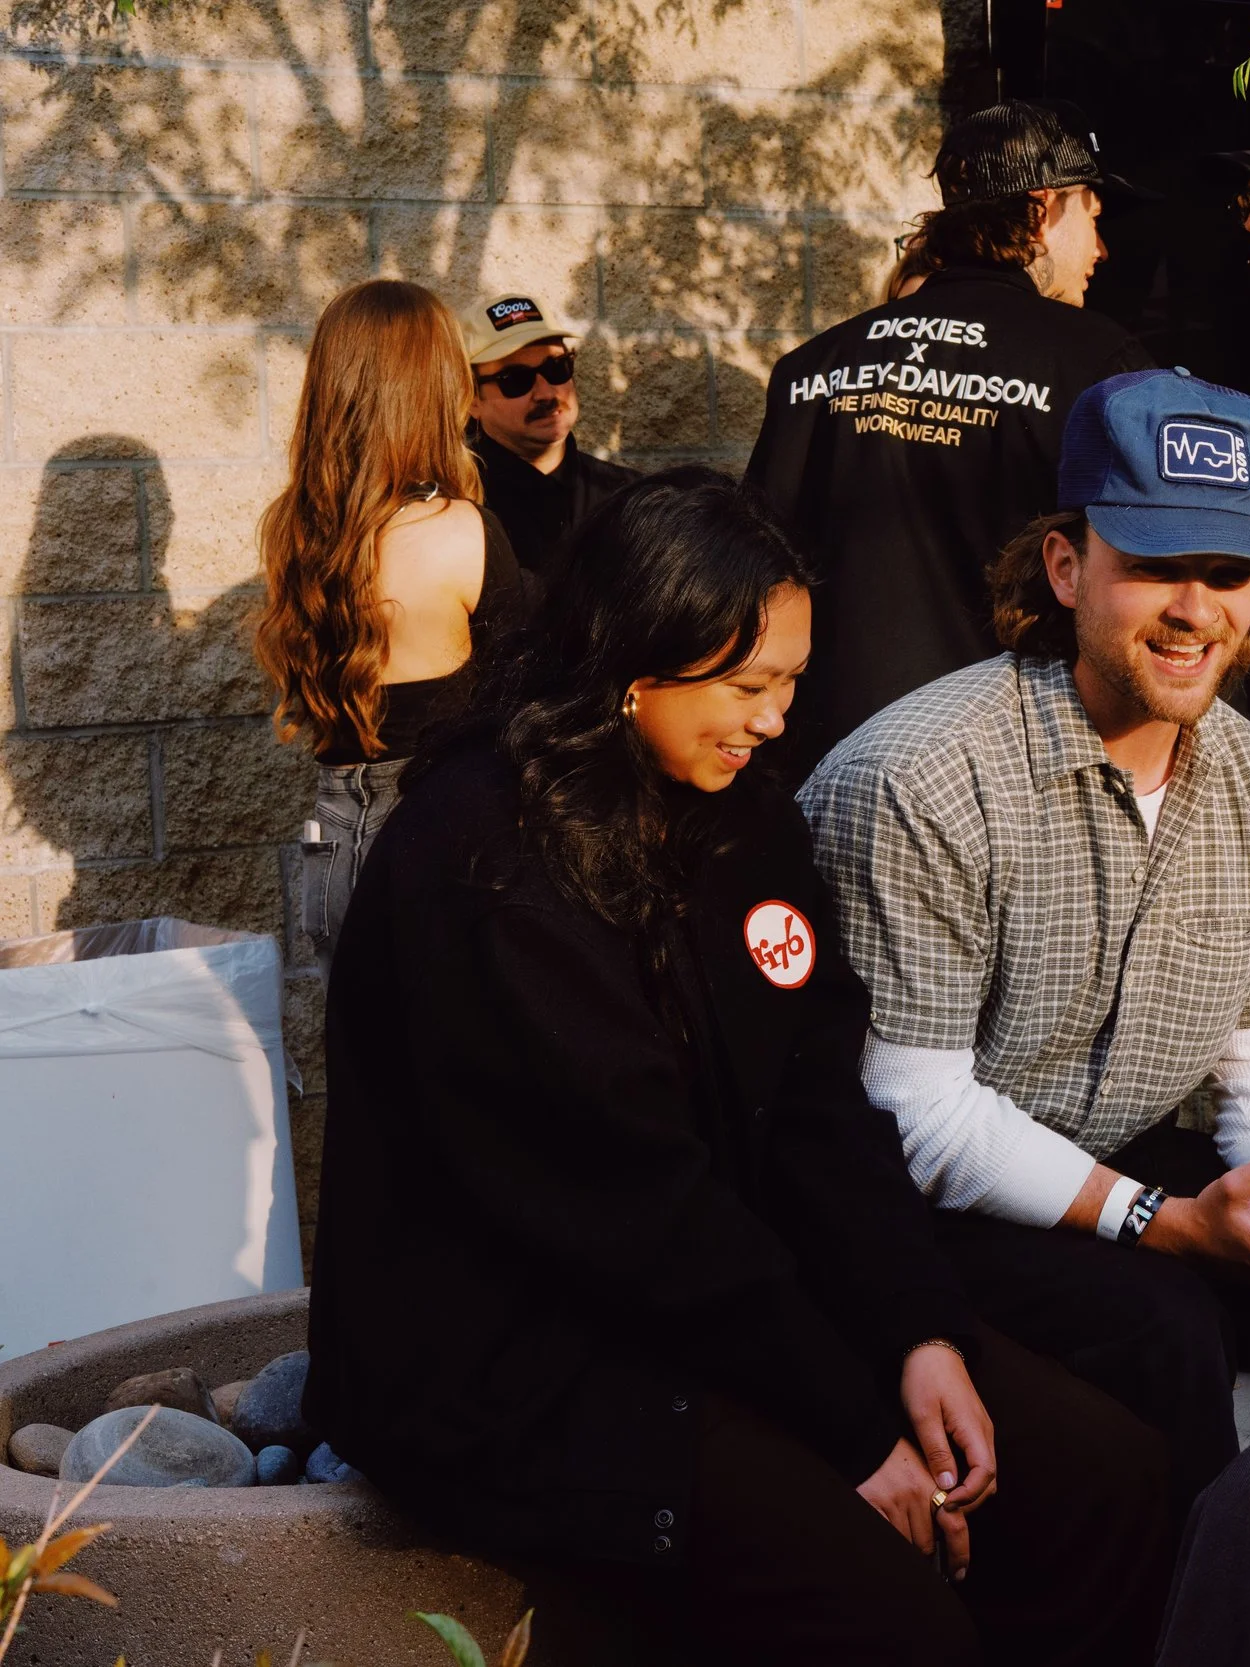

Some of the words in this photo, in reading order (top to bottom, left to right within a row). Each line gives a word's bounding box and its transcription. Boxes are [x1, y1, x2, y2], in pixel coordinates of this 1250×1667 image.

[492, 302, 532, 317] Coors
[828, 395, 858, 415] THE
[860, 392, 919, 417] FINEST
[921, 402, 999, 427] QUALITY
[854, 414, 962, 447] WORKWEAR
[1235, 436, 1250, 482] PSC
[1125, 1204, 1154, 1235] 21
